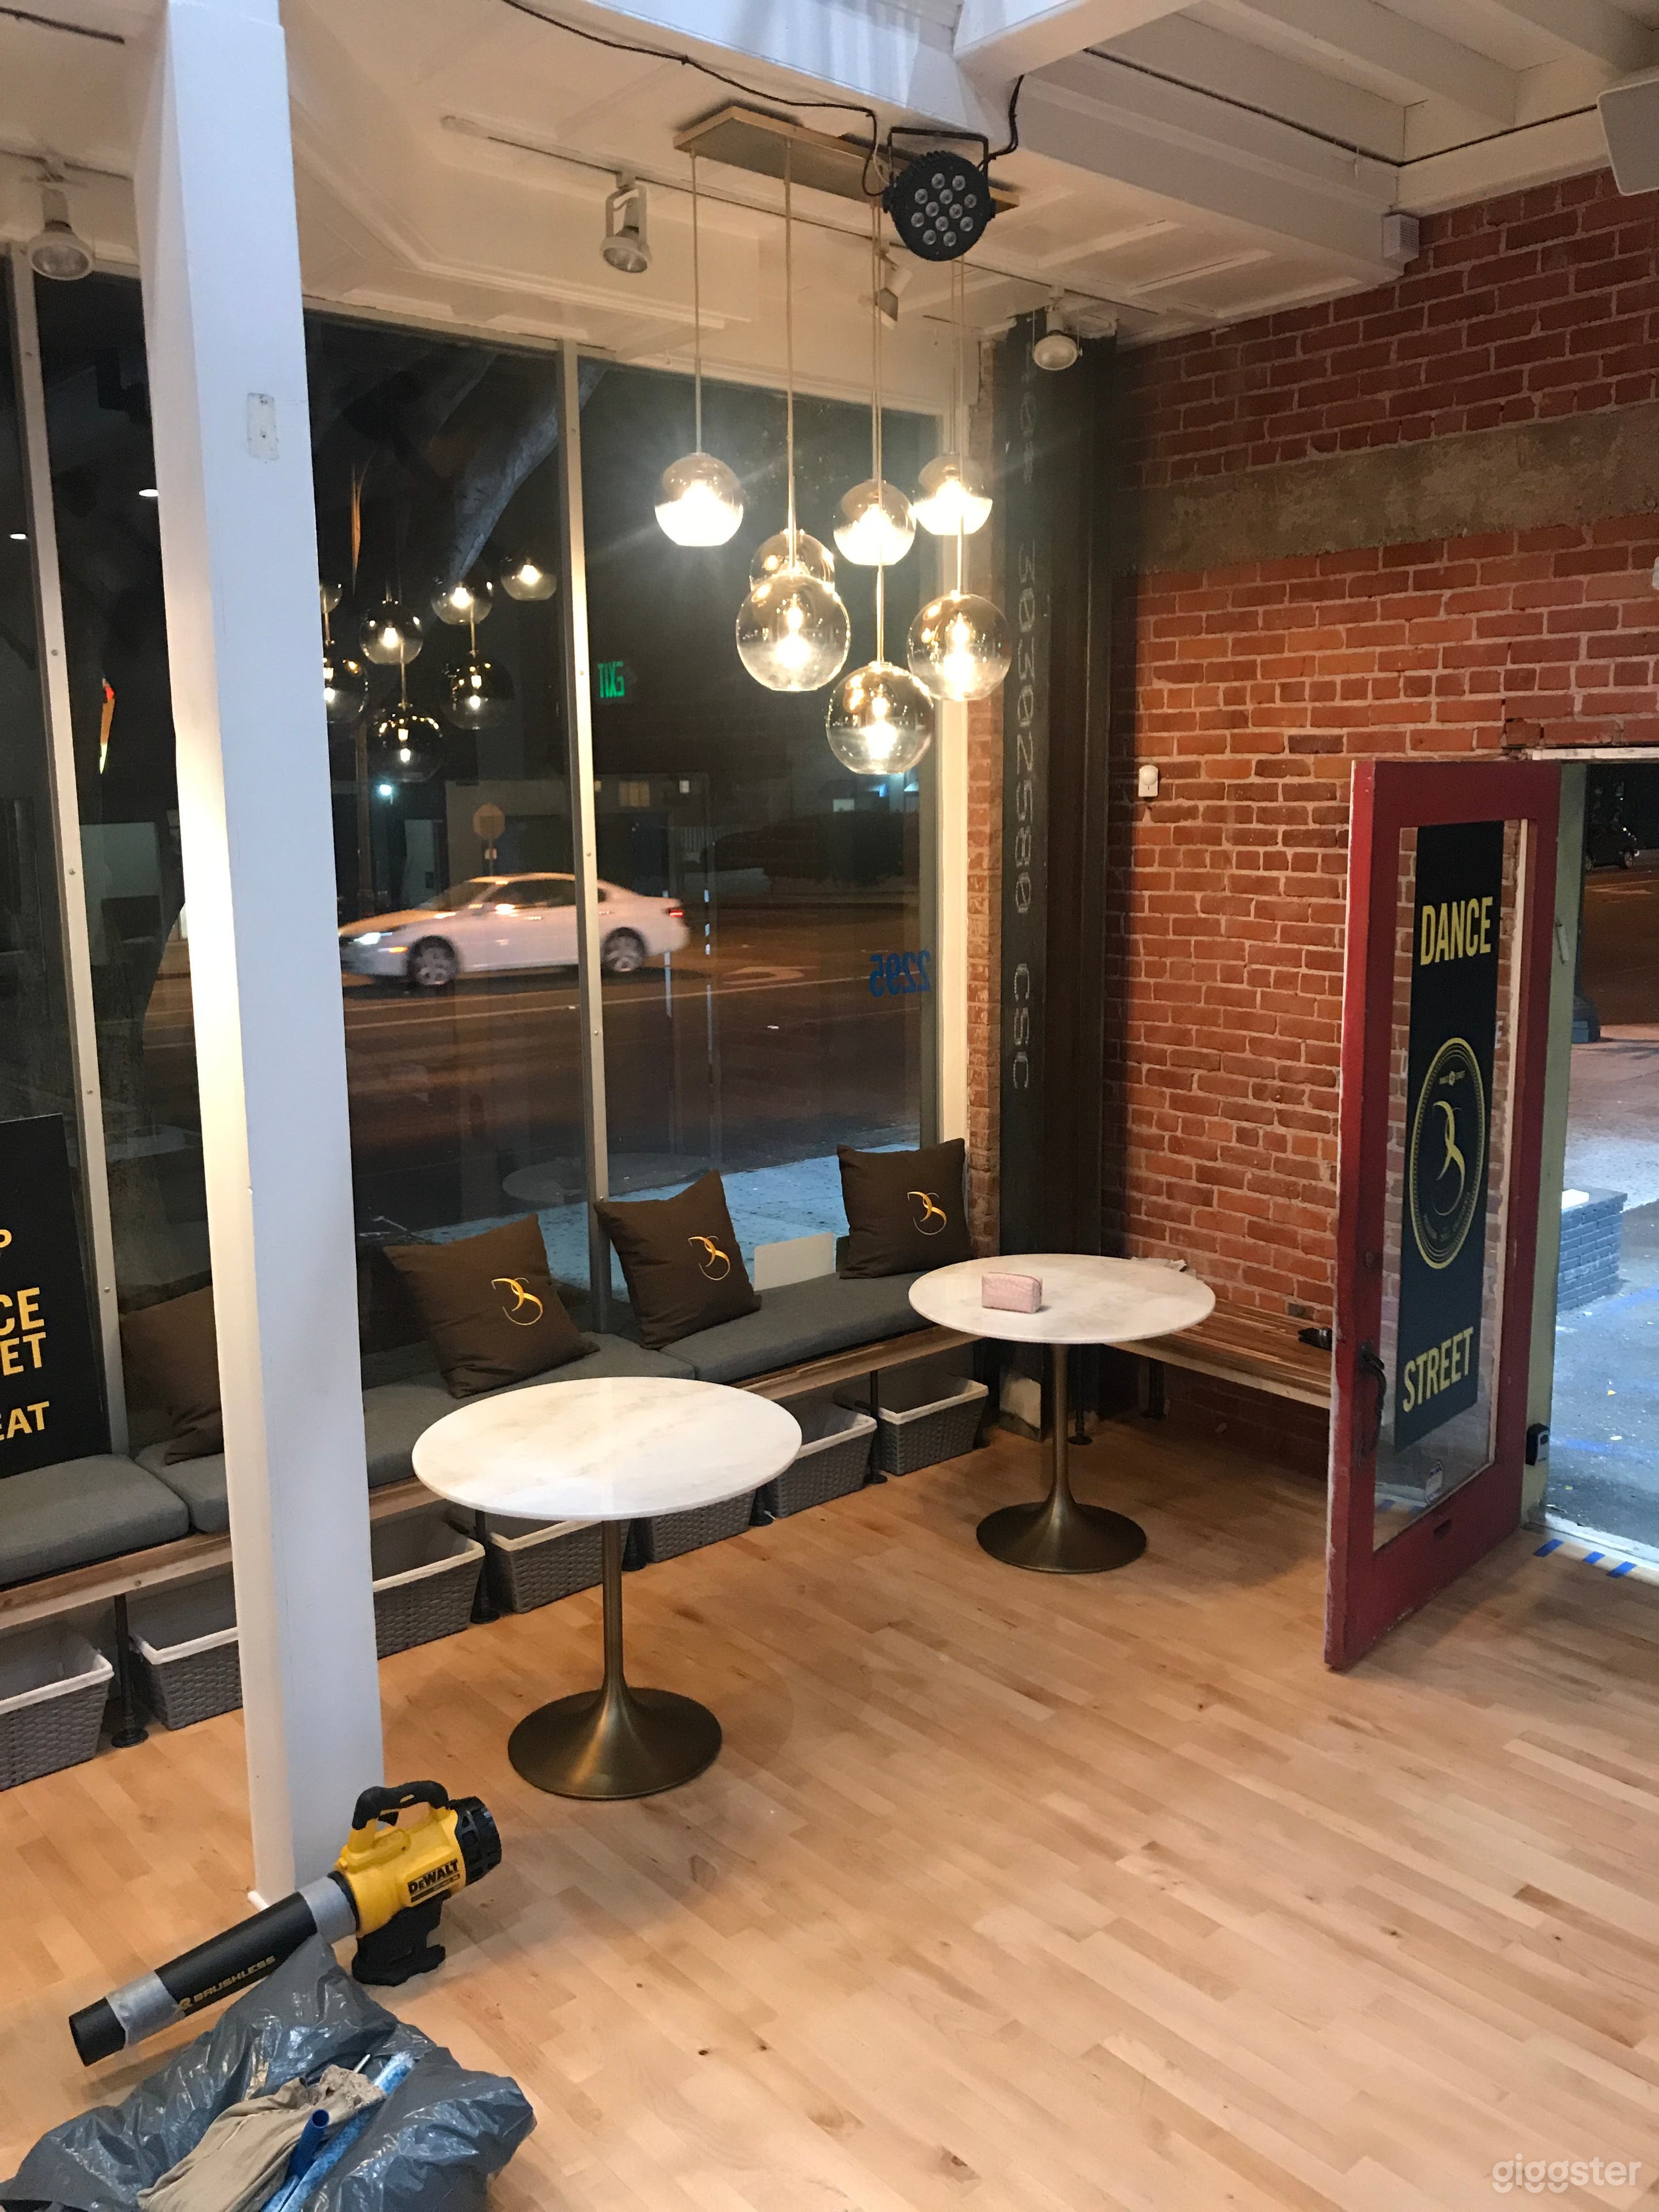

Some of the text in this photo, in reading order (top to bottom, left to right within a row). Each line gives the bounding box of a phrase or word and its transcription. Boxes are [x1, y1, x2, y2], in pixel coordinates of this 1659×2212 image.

[1420, 896, 1493, 965] DANCE
[1013, 963, 1030, 1089] CSC
[1403, 1326, 1474, 1412] STREET
[193, 1955, 276, 2003] BRUSHLESS
